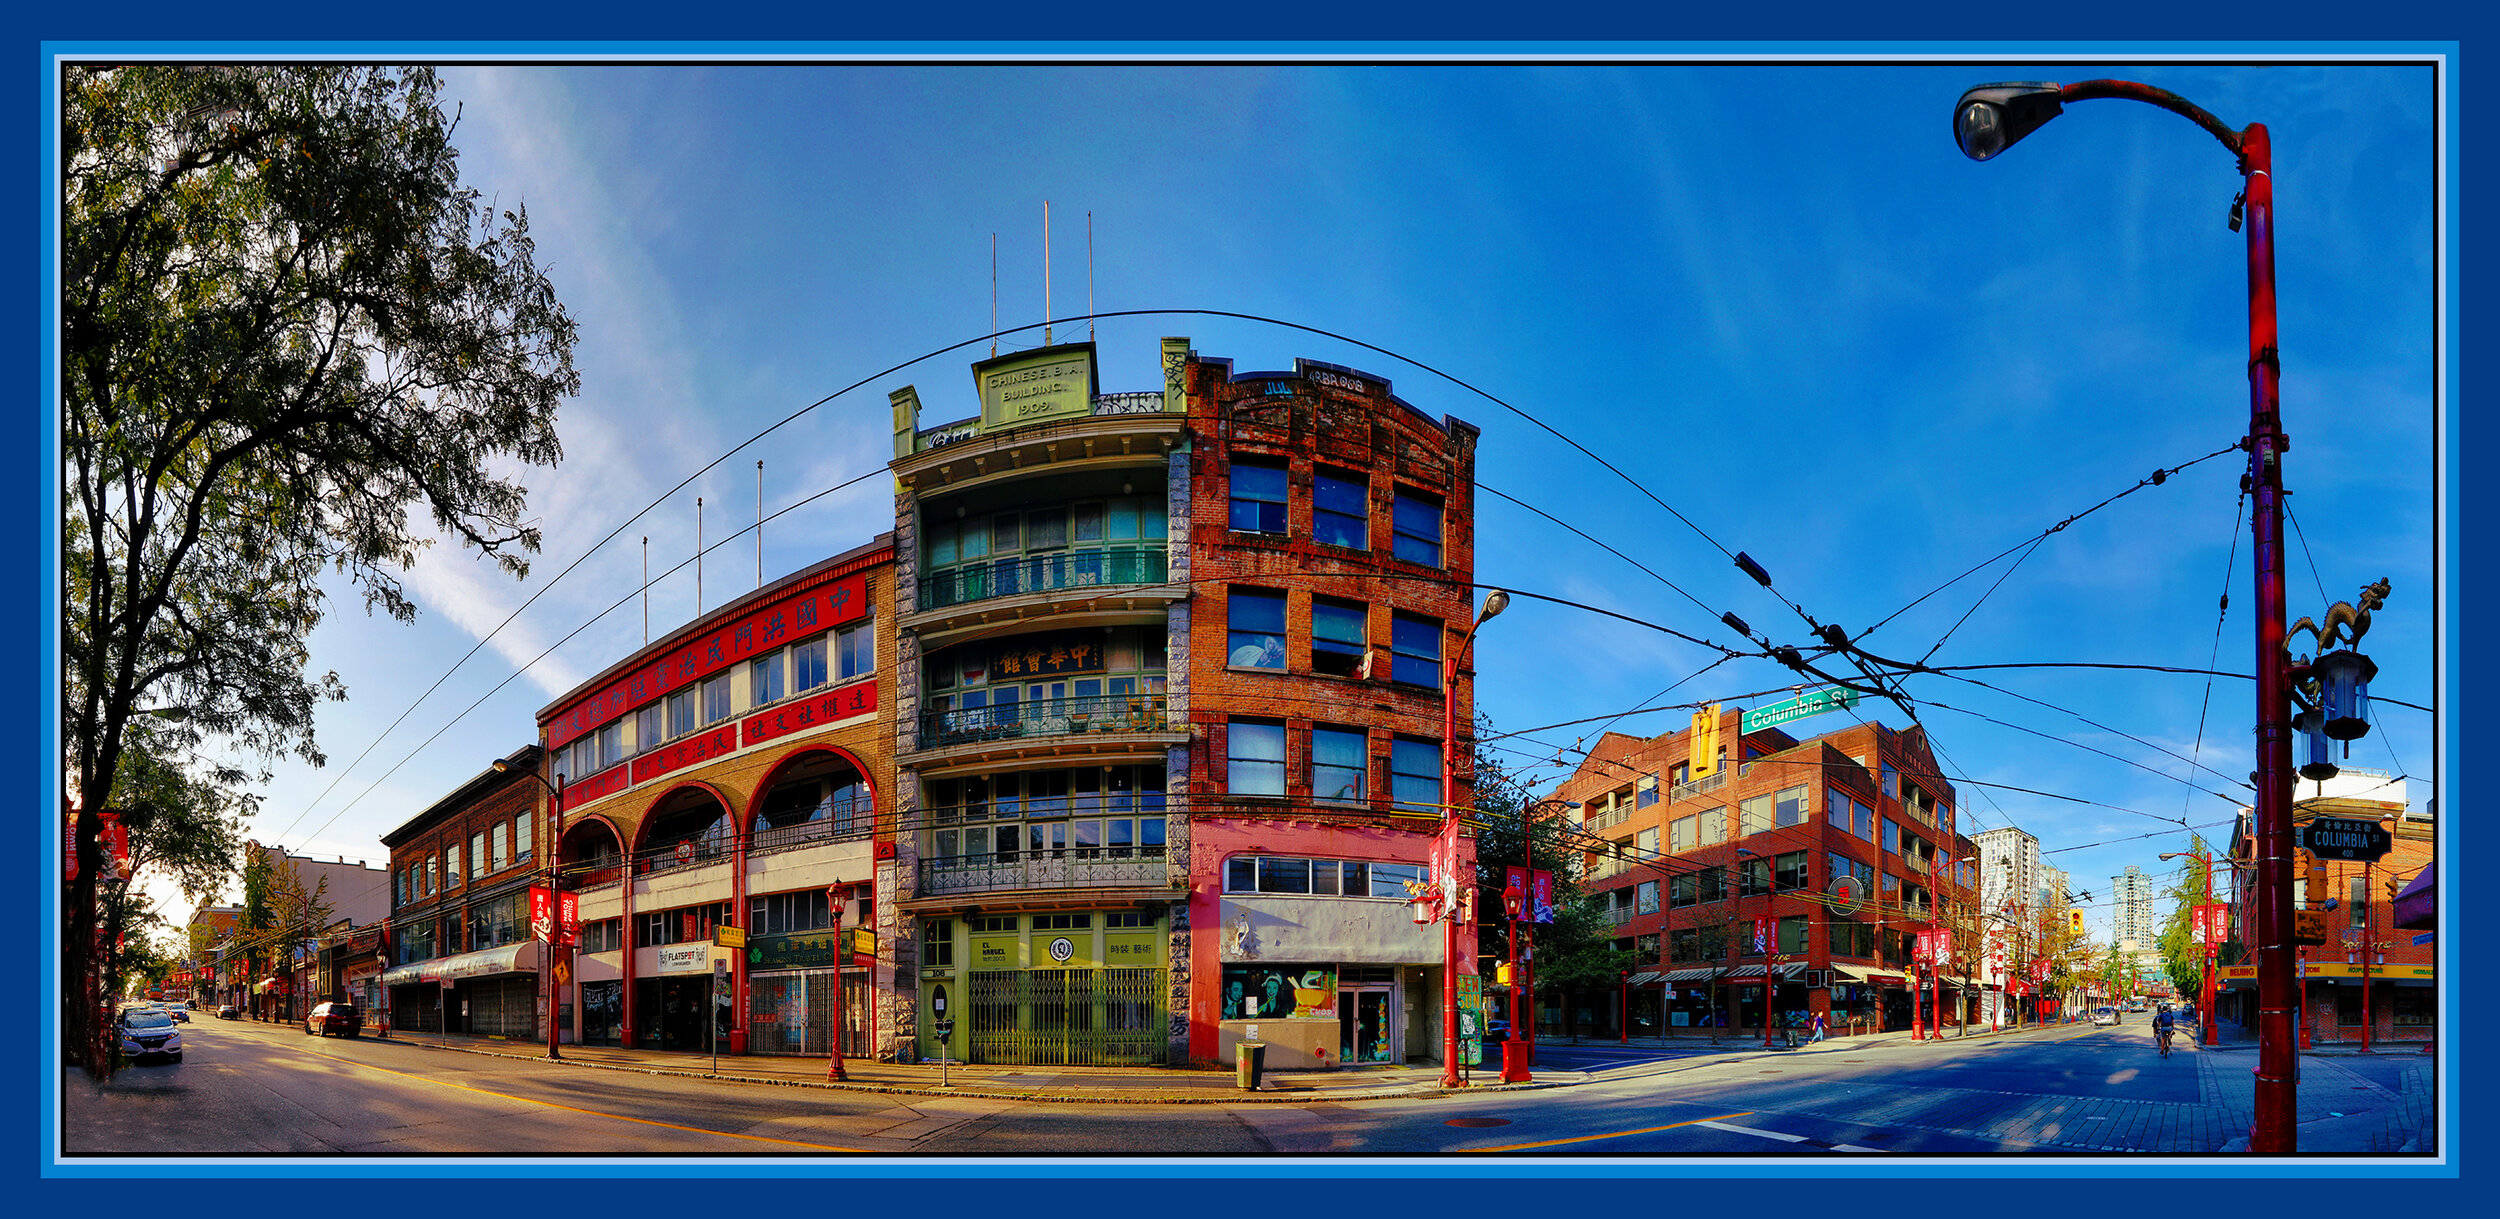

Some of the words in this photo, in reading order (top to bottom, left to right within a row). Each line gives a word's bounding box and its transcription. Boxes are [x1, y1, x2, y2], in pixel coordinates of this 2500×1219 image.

[1000, 644, 1091, 674] 中華會館
[1751, 697, 1823, 728] Columbia
[1829, 689, 1849, 707] St
[2315, 831, 2369, 848] COLUMBIA
[2342, 850, 2354, 858] 400
[2229, 967, 2255, 977] BEIJING
[1457, 977, 1479, 993] NEW
[1458, 994, 1480, 1009] SUN
[1309, 1007, 1333, 1017] CHOP
